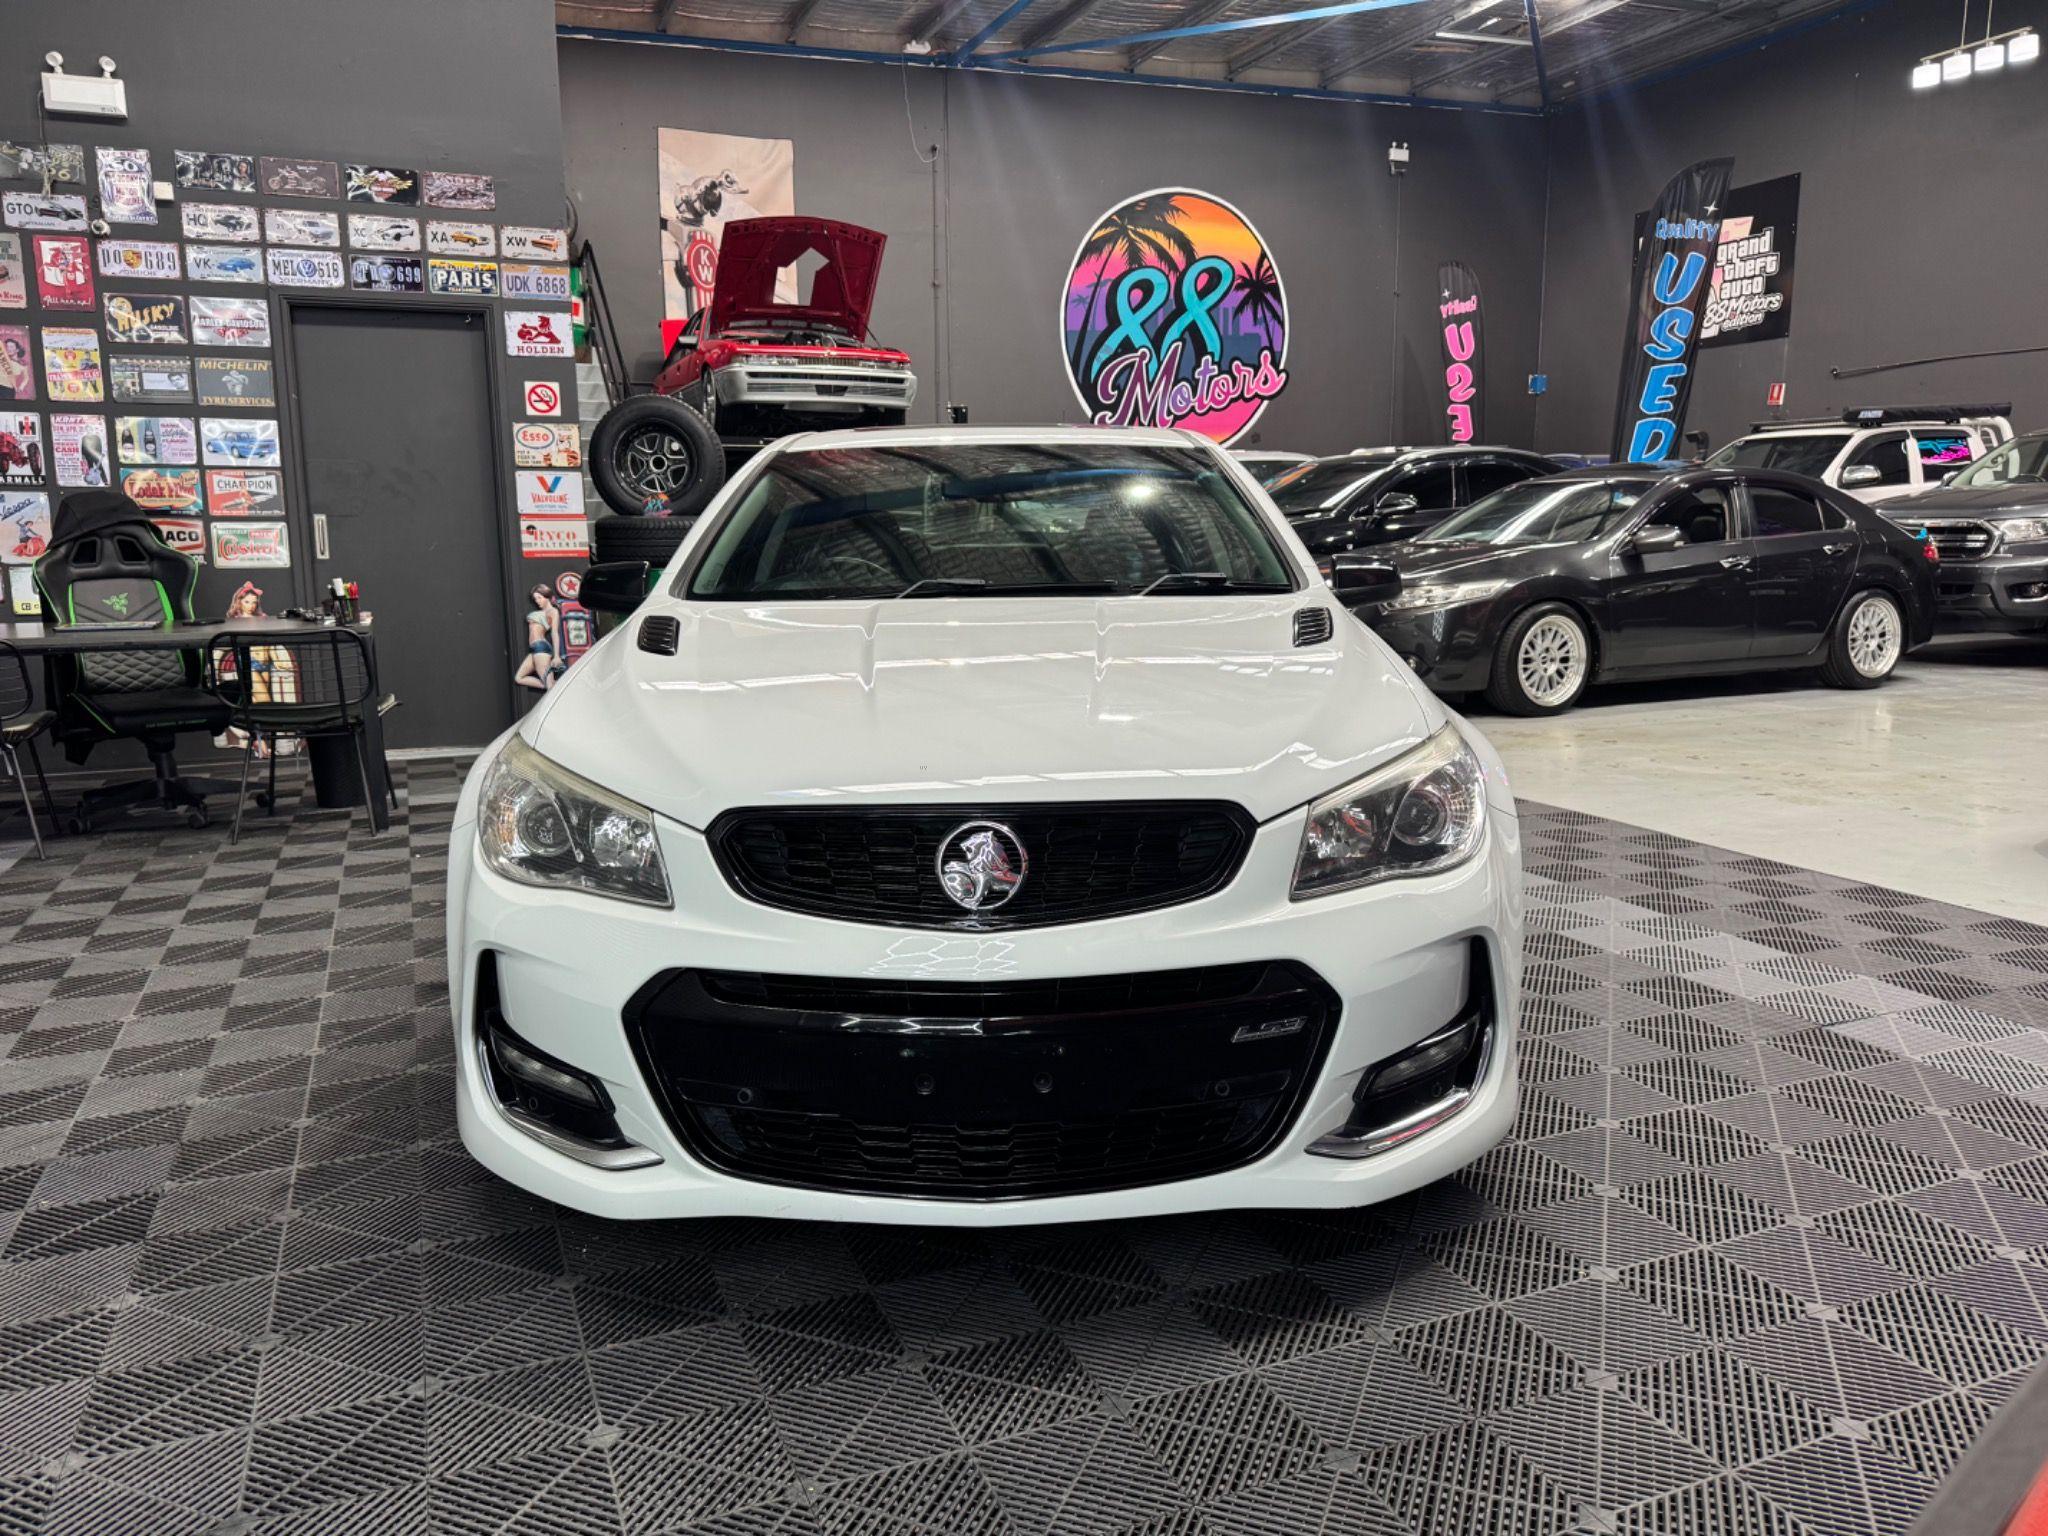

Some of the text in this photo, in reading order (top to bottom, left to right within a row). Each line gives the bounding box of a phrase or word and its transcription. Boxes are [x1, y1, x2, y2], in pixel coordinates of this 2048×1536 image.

[6, 202, 33, 215] GTO
[1655, 218, 1718, 242] Quality
[431, 231, 448, 243] XA
[506, 236, 527, 247] XW
[145, 250, 176, 271] 689
[272, 259, 297, 276] MEL
[436, 270, 493, 287] PARIS
[506, 275, 566, 293] UDK 6868
[117, 302, 175, 332] HUSKY
[1091, 256, 1235, 384] 88
[516, 345, 565, 355] HOLDEN
[1628, 252, 1706, 463] USED
[200, 361, 268, 371] MICHELIN
[1094, 342, 1287, 428] Motors
[521, 429, 550, 442] Esso
[0, 476, 45, 484] ARMALL
[217, 480, 273, 489] CHAMPION
[165, 531, 200, 542] ACO
[533, 530, 577, 541] RYCO
